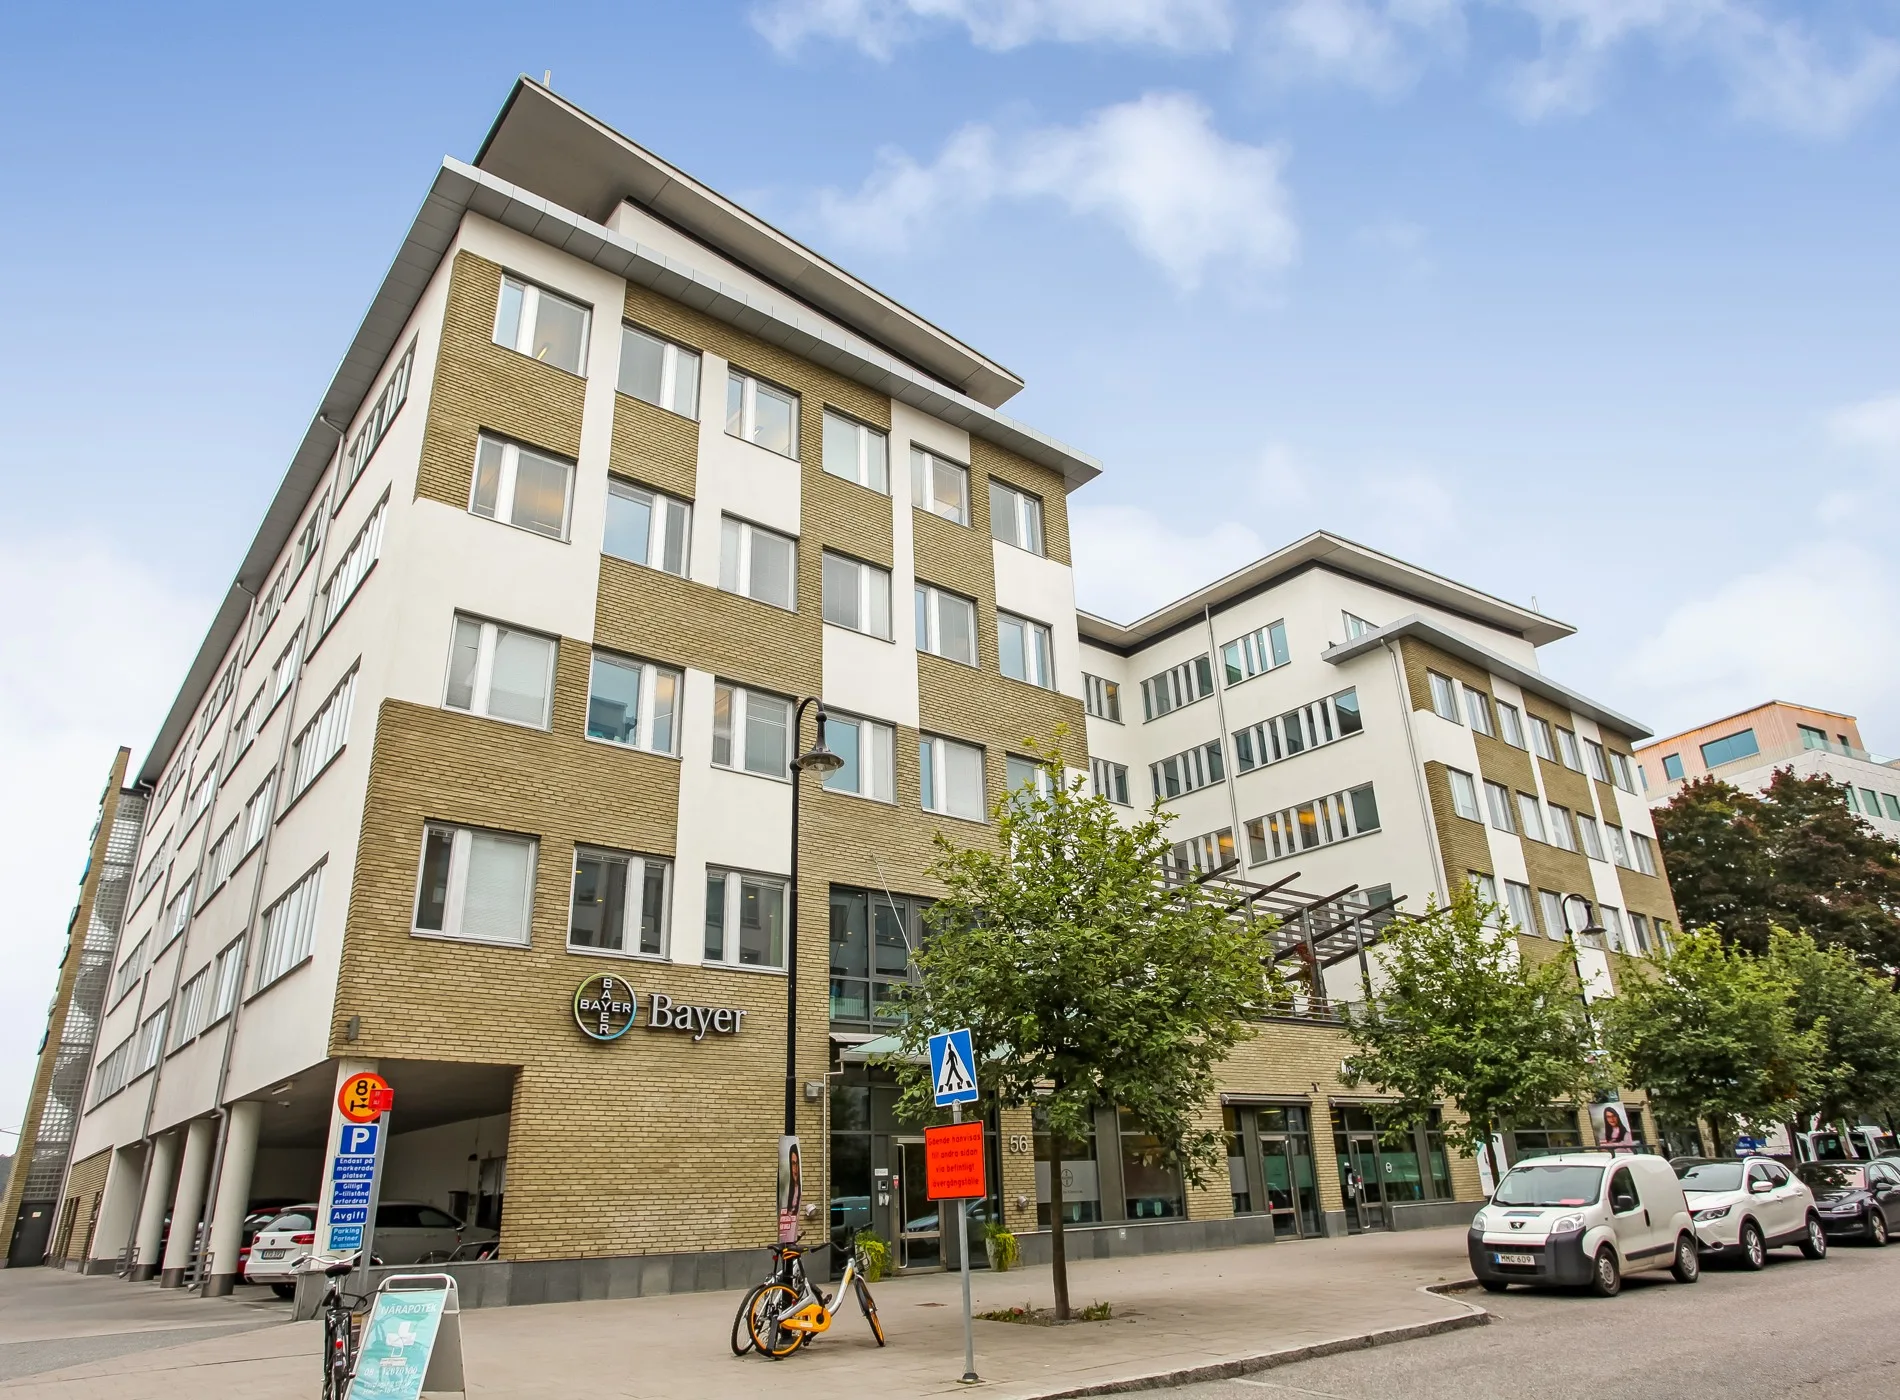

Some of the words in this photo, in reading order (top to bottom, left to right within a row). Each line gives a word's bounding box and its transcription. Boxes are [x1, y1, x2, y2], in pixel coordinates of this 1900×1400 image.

[580, 999, 632, 1013] BAYER
[599, 978, 613, 1034] BAYER
[648, 994, 748, 1041] Bayer
[350, 1127, 370, 1153] P
[1010, 1135, 1028, 1152] 56
[940, 1149, 959, 1159] andra
[960, 1148, 978, 1157] sidan
[364, 1157, 373, 1165] på
[333, 1211, 365, 1221] Avgift
[333, 1227, 360, 1235] Parking
[380, 1303, 438, 1315] NÄRAPOTEK
